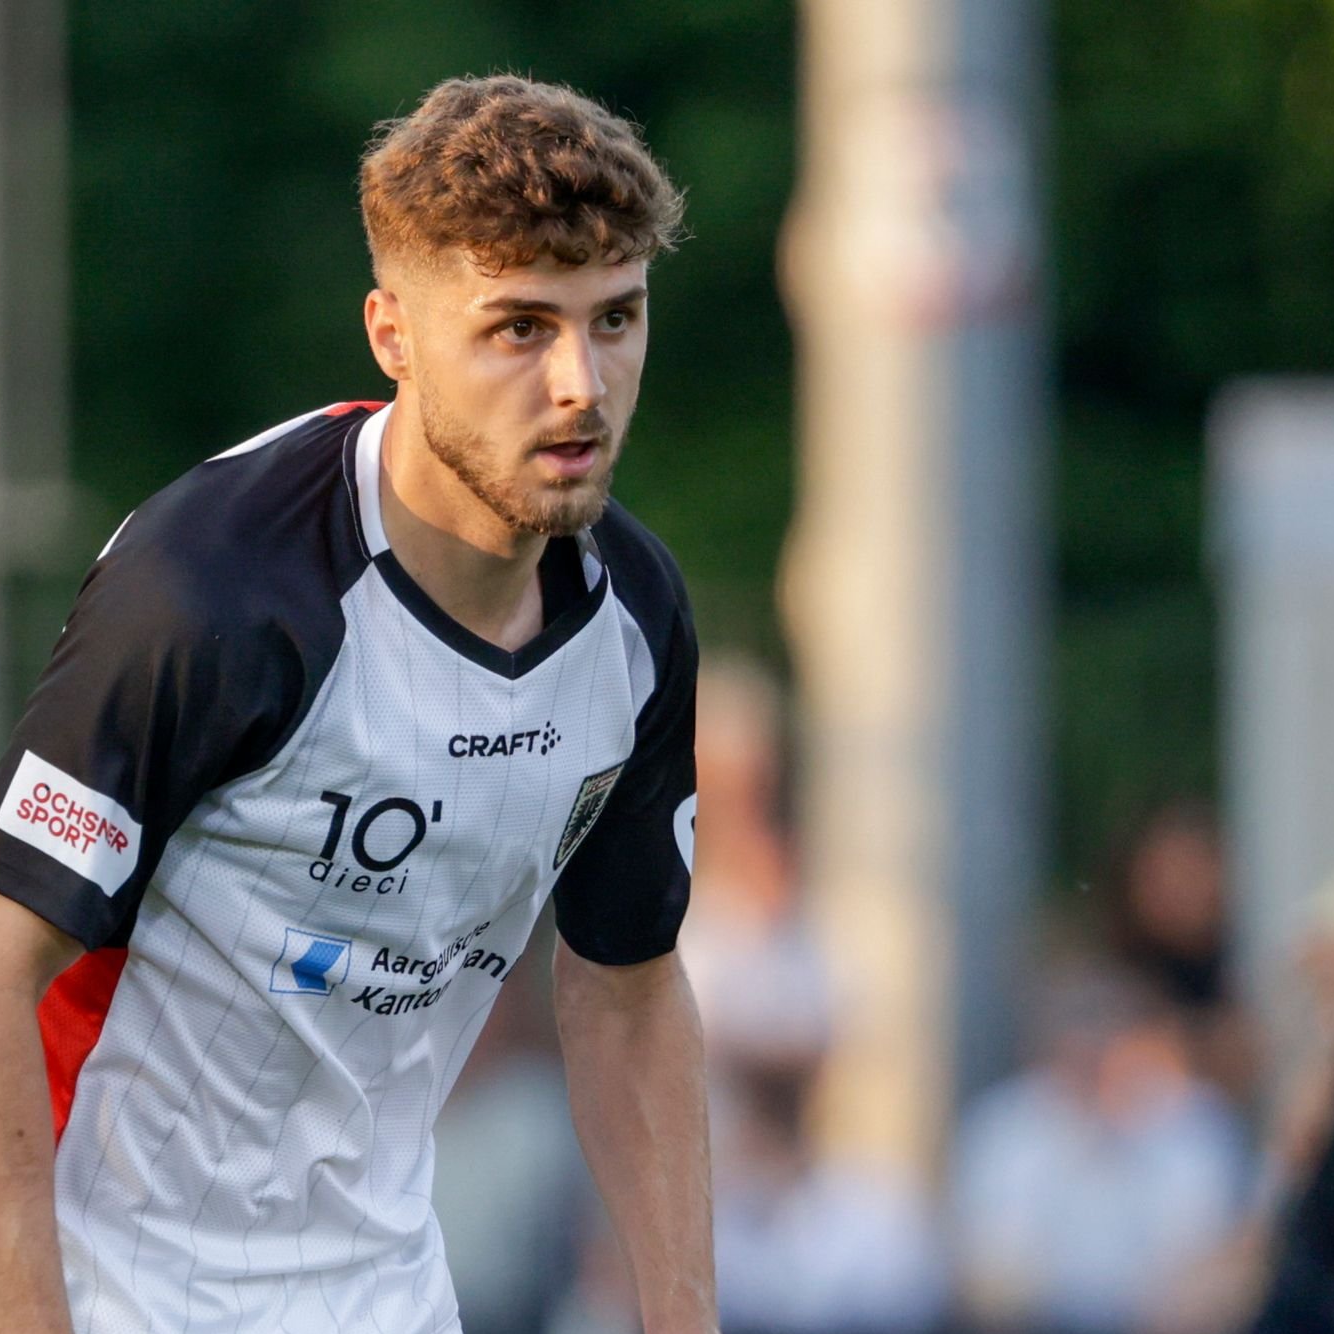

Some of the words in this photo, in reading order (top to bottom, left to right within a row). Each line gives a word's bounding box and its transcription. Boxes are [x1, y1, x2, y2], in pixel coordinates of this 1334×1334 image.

[447, 729, 541, 759] CRAFT
[16, 798, 98, 855] SPORT
[32, 782, 129, 856] OCHSNER
[308, 860, 410, 895] dieci
